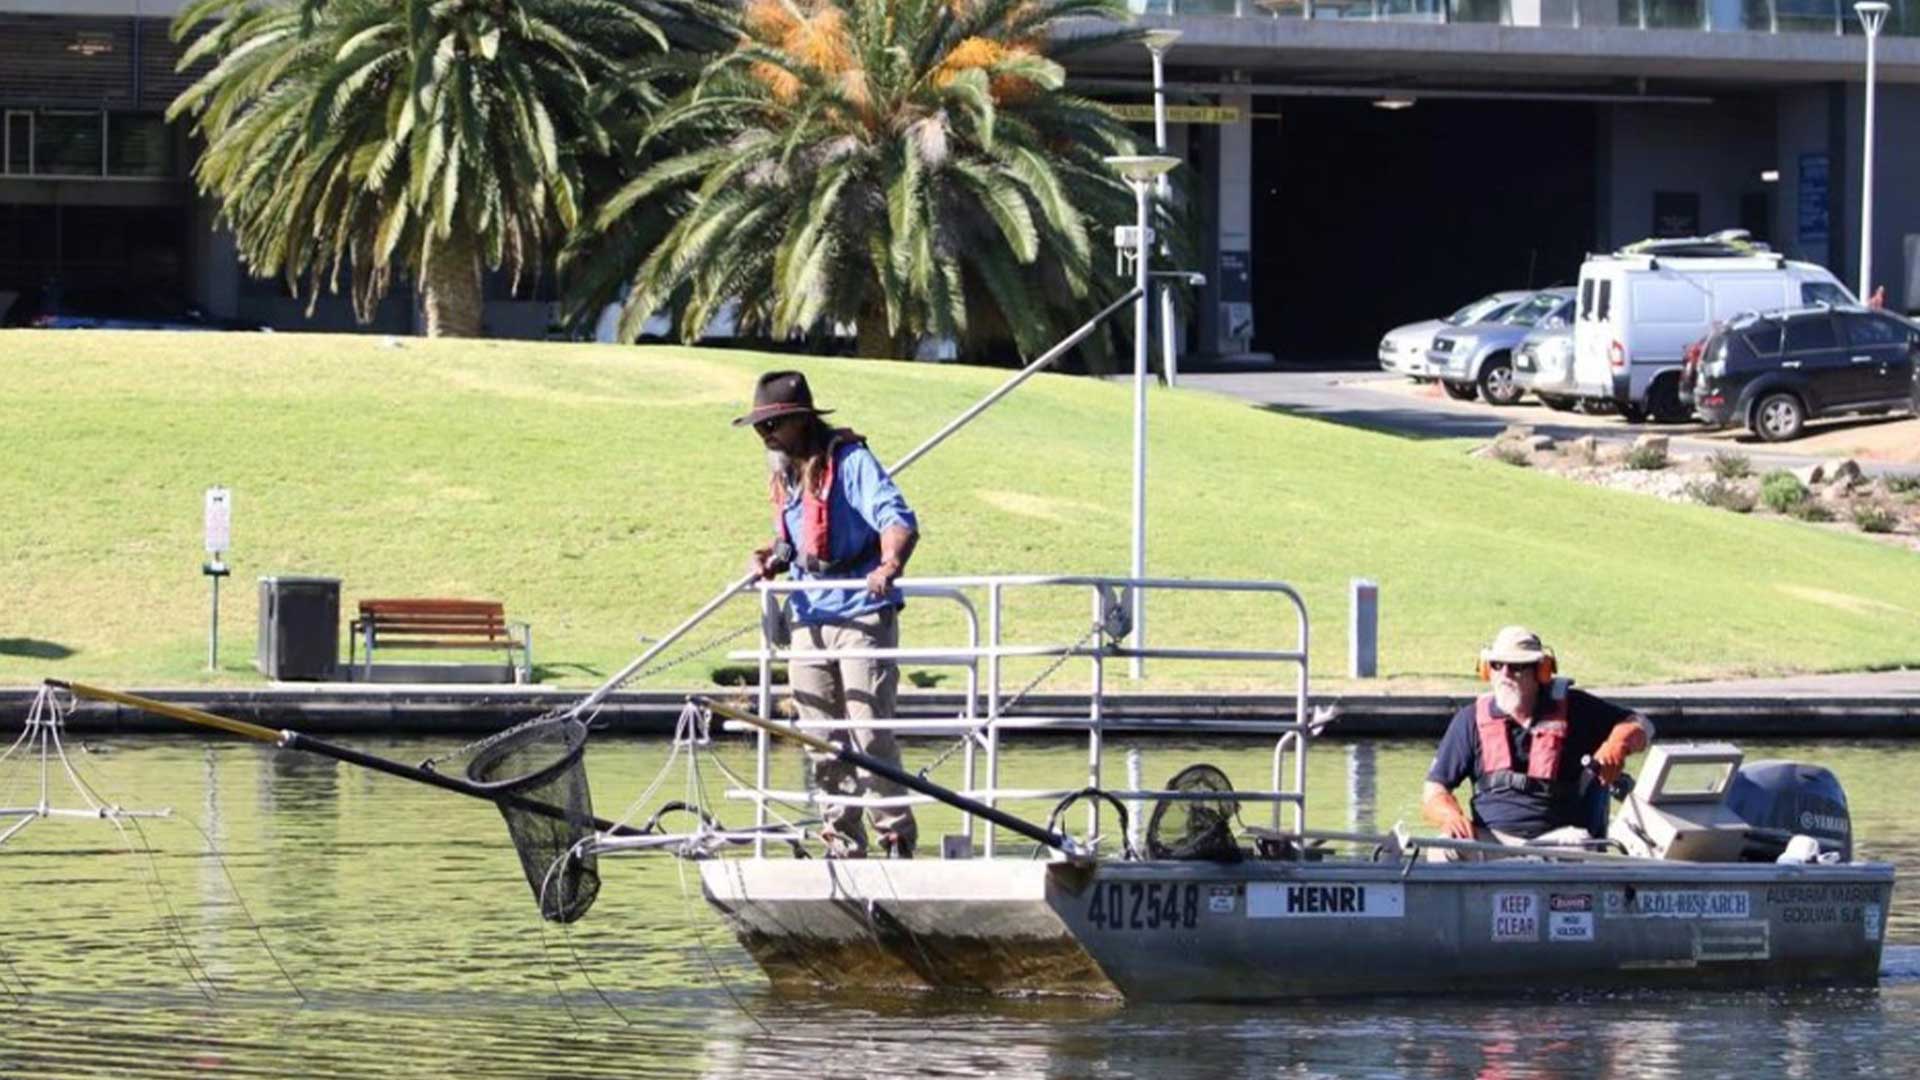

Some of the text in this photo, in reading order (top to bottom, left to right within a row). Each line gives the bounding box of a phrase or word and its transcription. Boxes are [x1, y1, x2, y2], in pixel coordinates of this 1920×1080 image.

[1286, 886, 1366, 913] HENRI
[1501, 895, 1531, 913] KEEP
[1497, 917, 1535, 935] CLEAR
